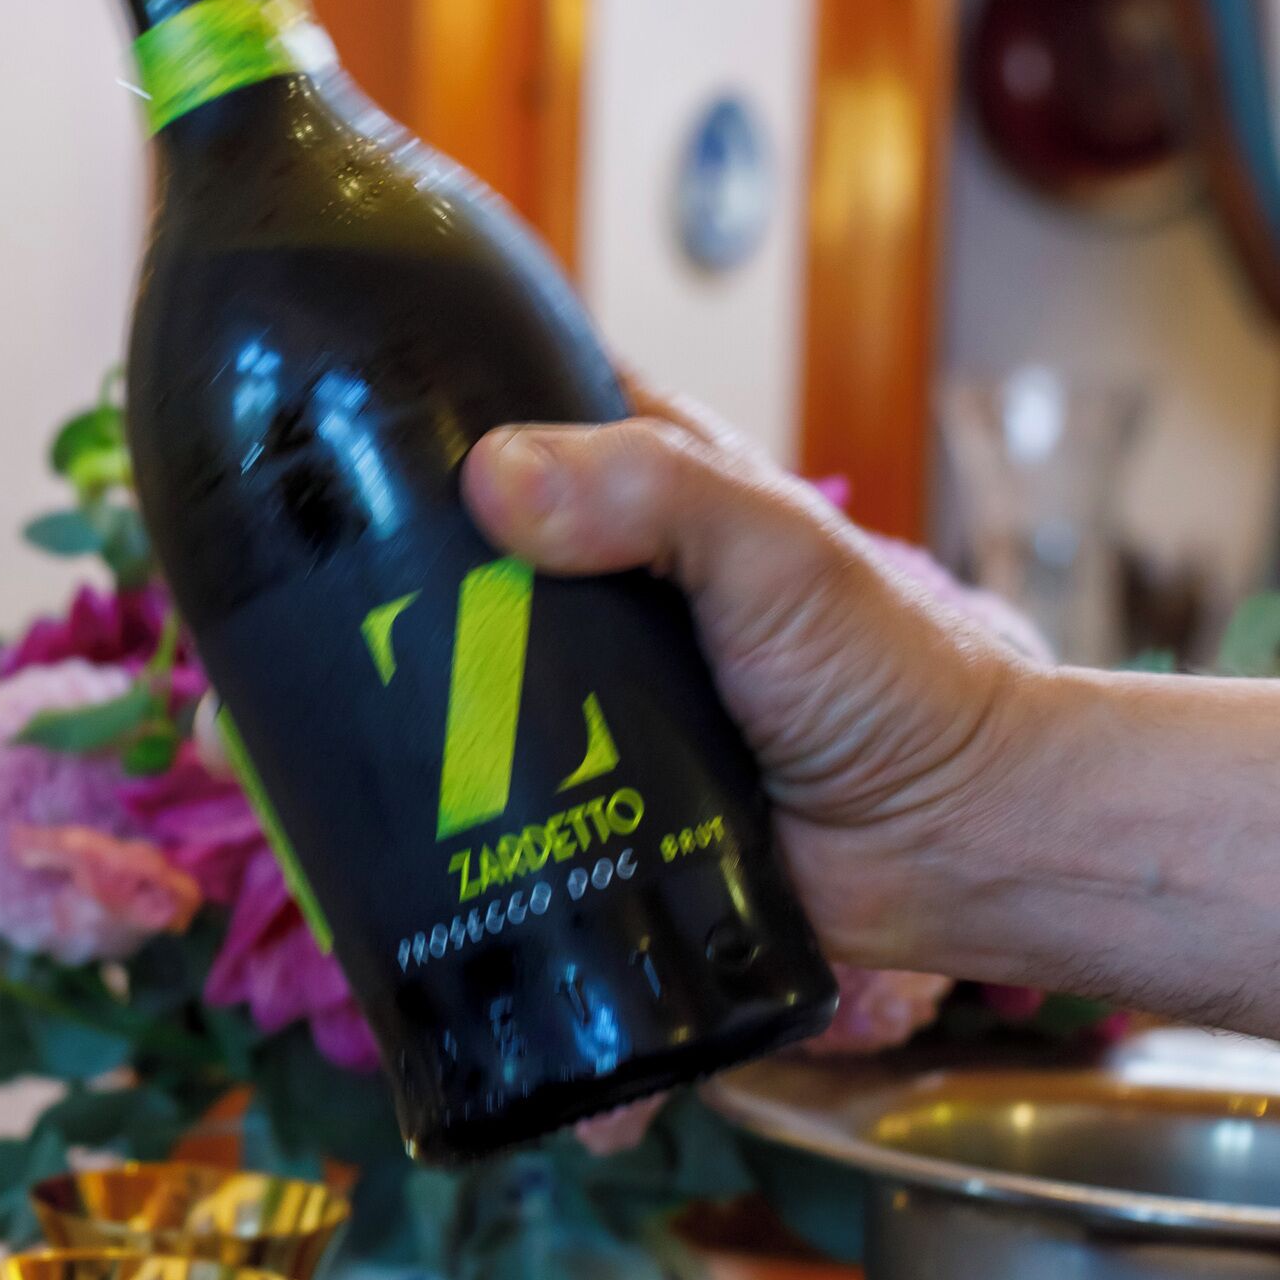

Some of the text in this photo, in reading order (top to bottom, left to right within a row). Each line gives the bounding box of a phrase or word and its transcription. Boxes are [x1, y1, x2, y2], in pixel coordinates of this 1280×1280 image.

[397, 815, 725, 974] PROSECCO DOC BRUT
[448, 787, 645, 903] ZARDETTO
